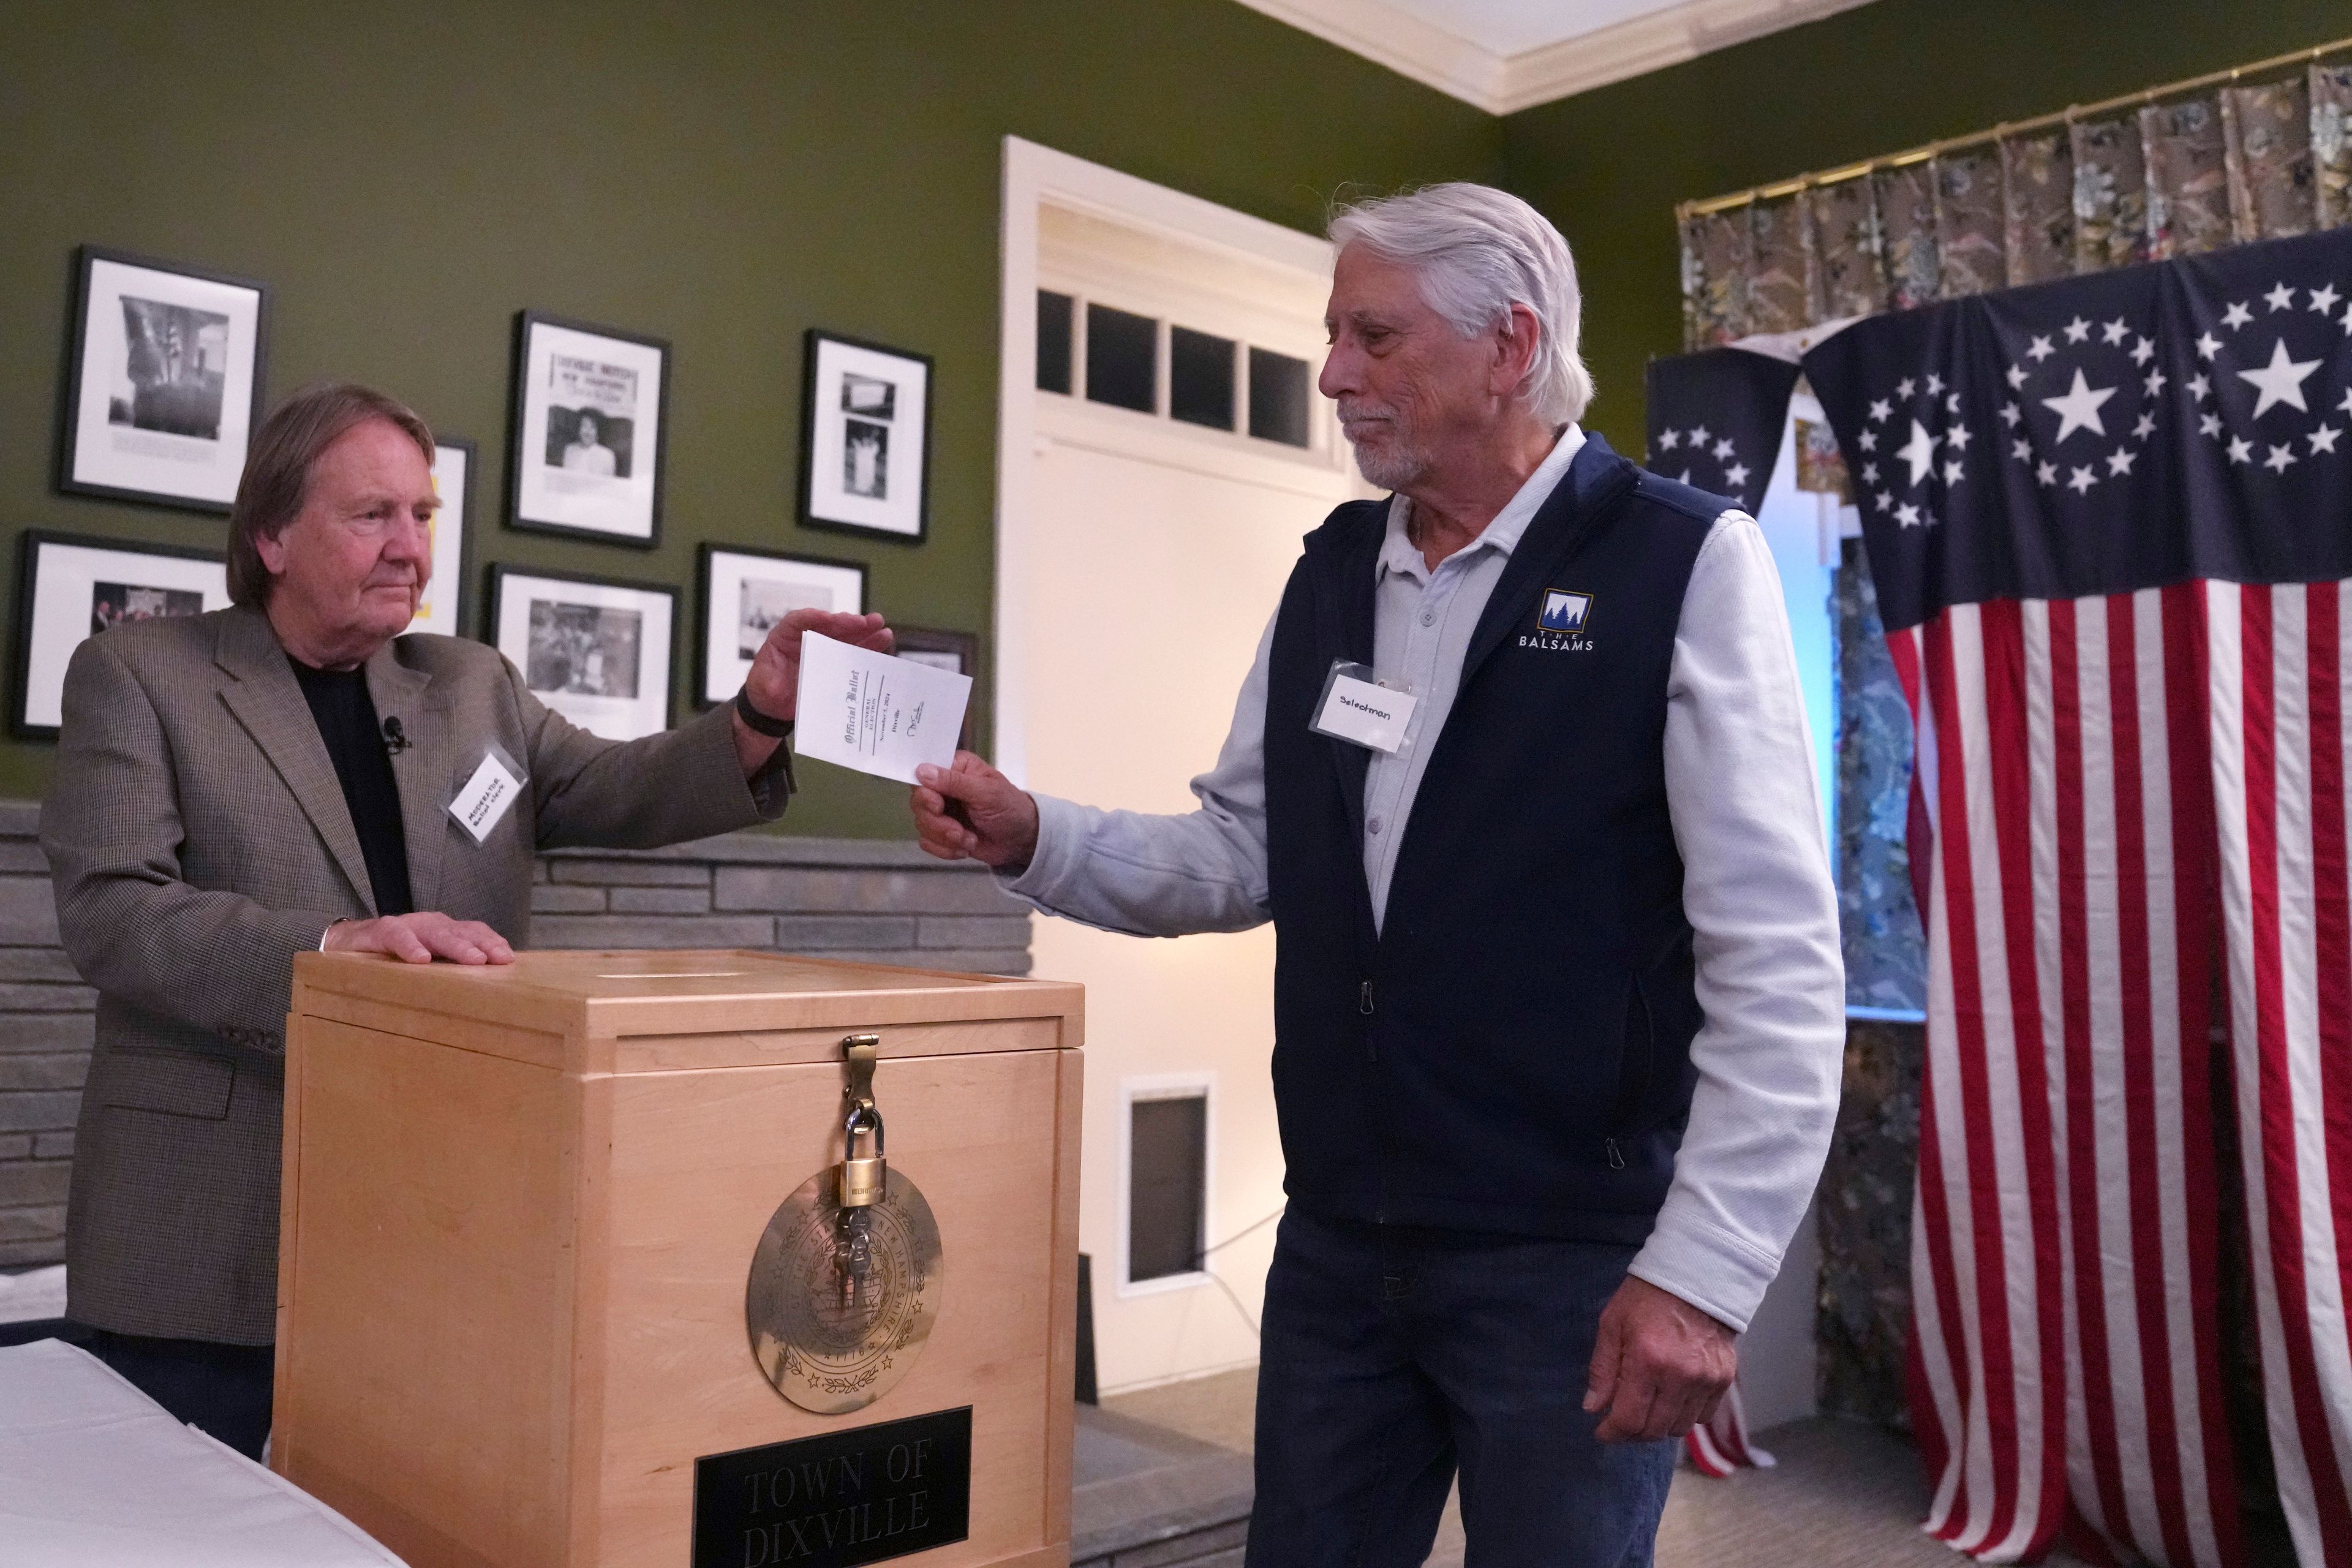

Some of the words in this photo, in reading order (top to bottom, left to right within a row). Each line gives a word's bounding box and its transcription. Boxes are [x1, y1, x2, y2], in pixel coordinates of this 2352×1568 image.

[1518, 636, 1594, 651] BALSAMS
[846, 670, 859, 703] Ballot
[844, 706, 857, 744] Official
[1340, 696, 1390, 720] Selectman
[877, 1220, 898, 1244] NEW
[882, 1249, 907, 1333] HAMPSHIRE
[744, 1453, 864, 1513] TOWN
[886, 1438, 932, 1482] OF
[743, 1490, 930, 1568] DIXVILLE
